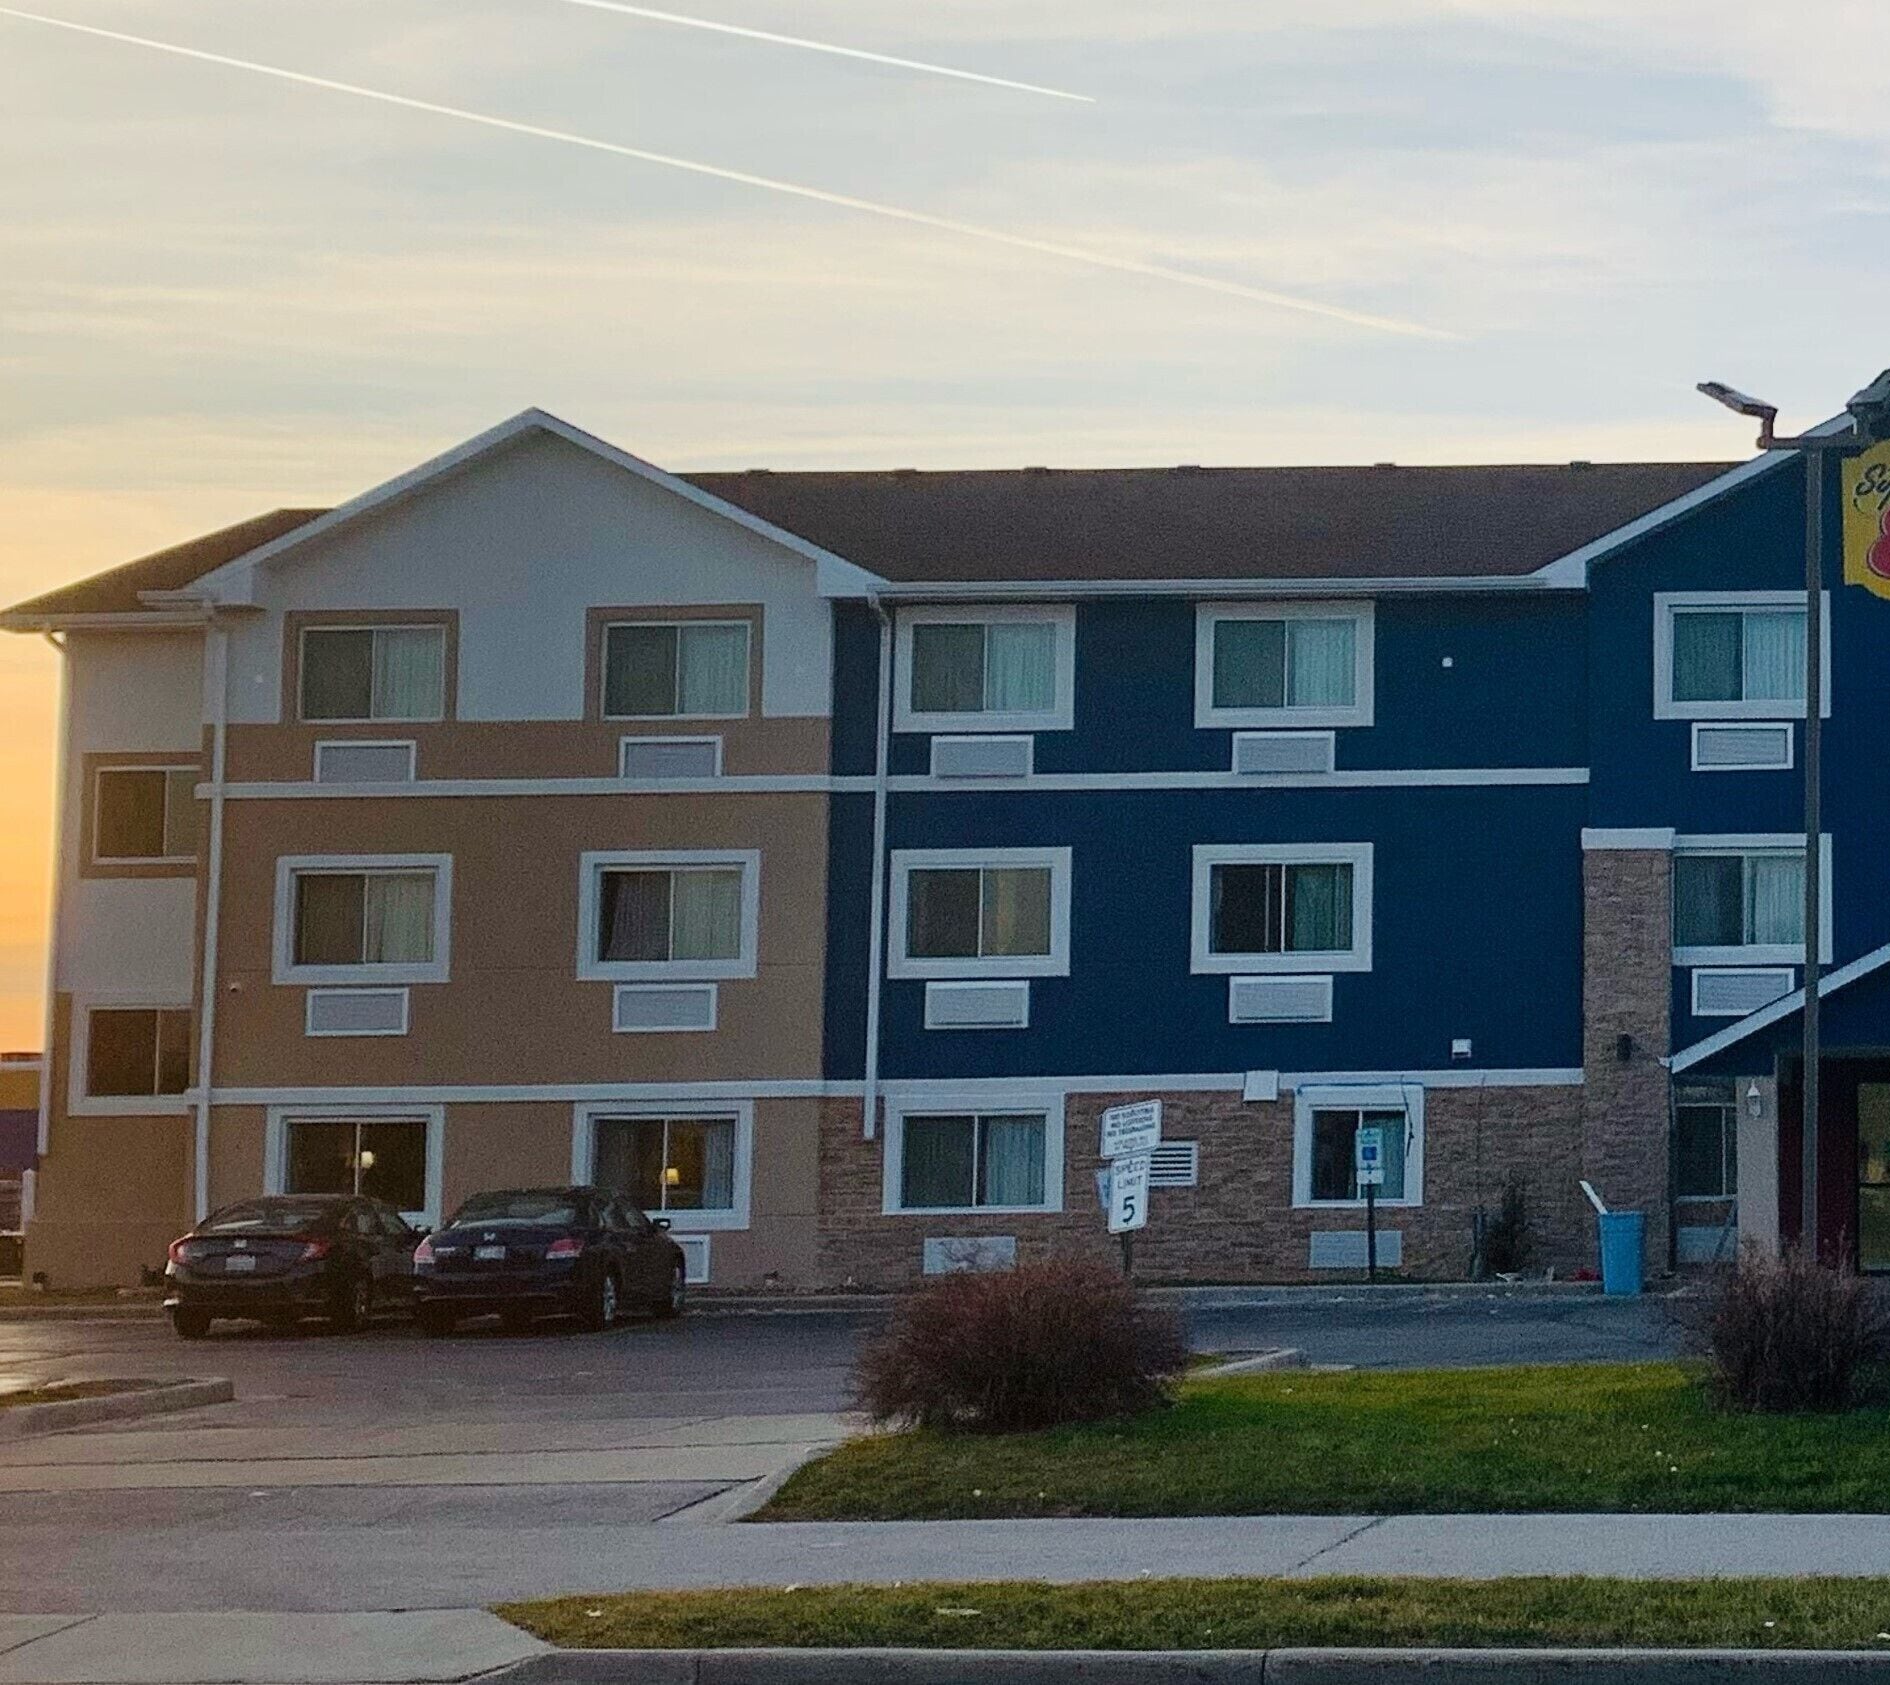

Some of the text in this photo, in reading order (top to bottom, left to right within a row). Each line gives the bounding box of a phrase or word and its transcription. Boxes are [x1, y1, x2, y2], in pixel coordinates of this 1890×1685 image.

[1115, 1161, 1146, 1176] SPEED
[1117, 1175, 1143, 1189] LIMIT
[1123, 1196, 1135, 1223] 5
